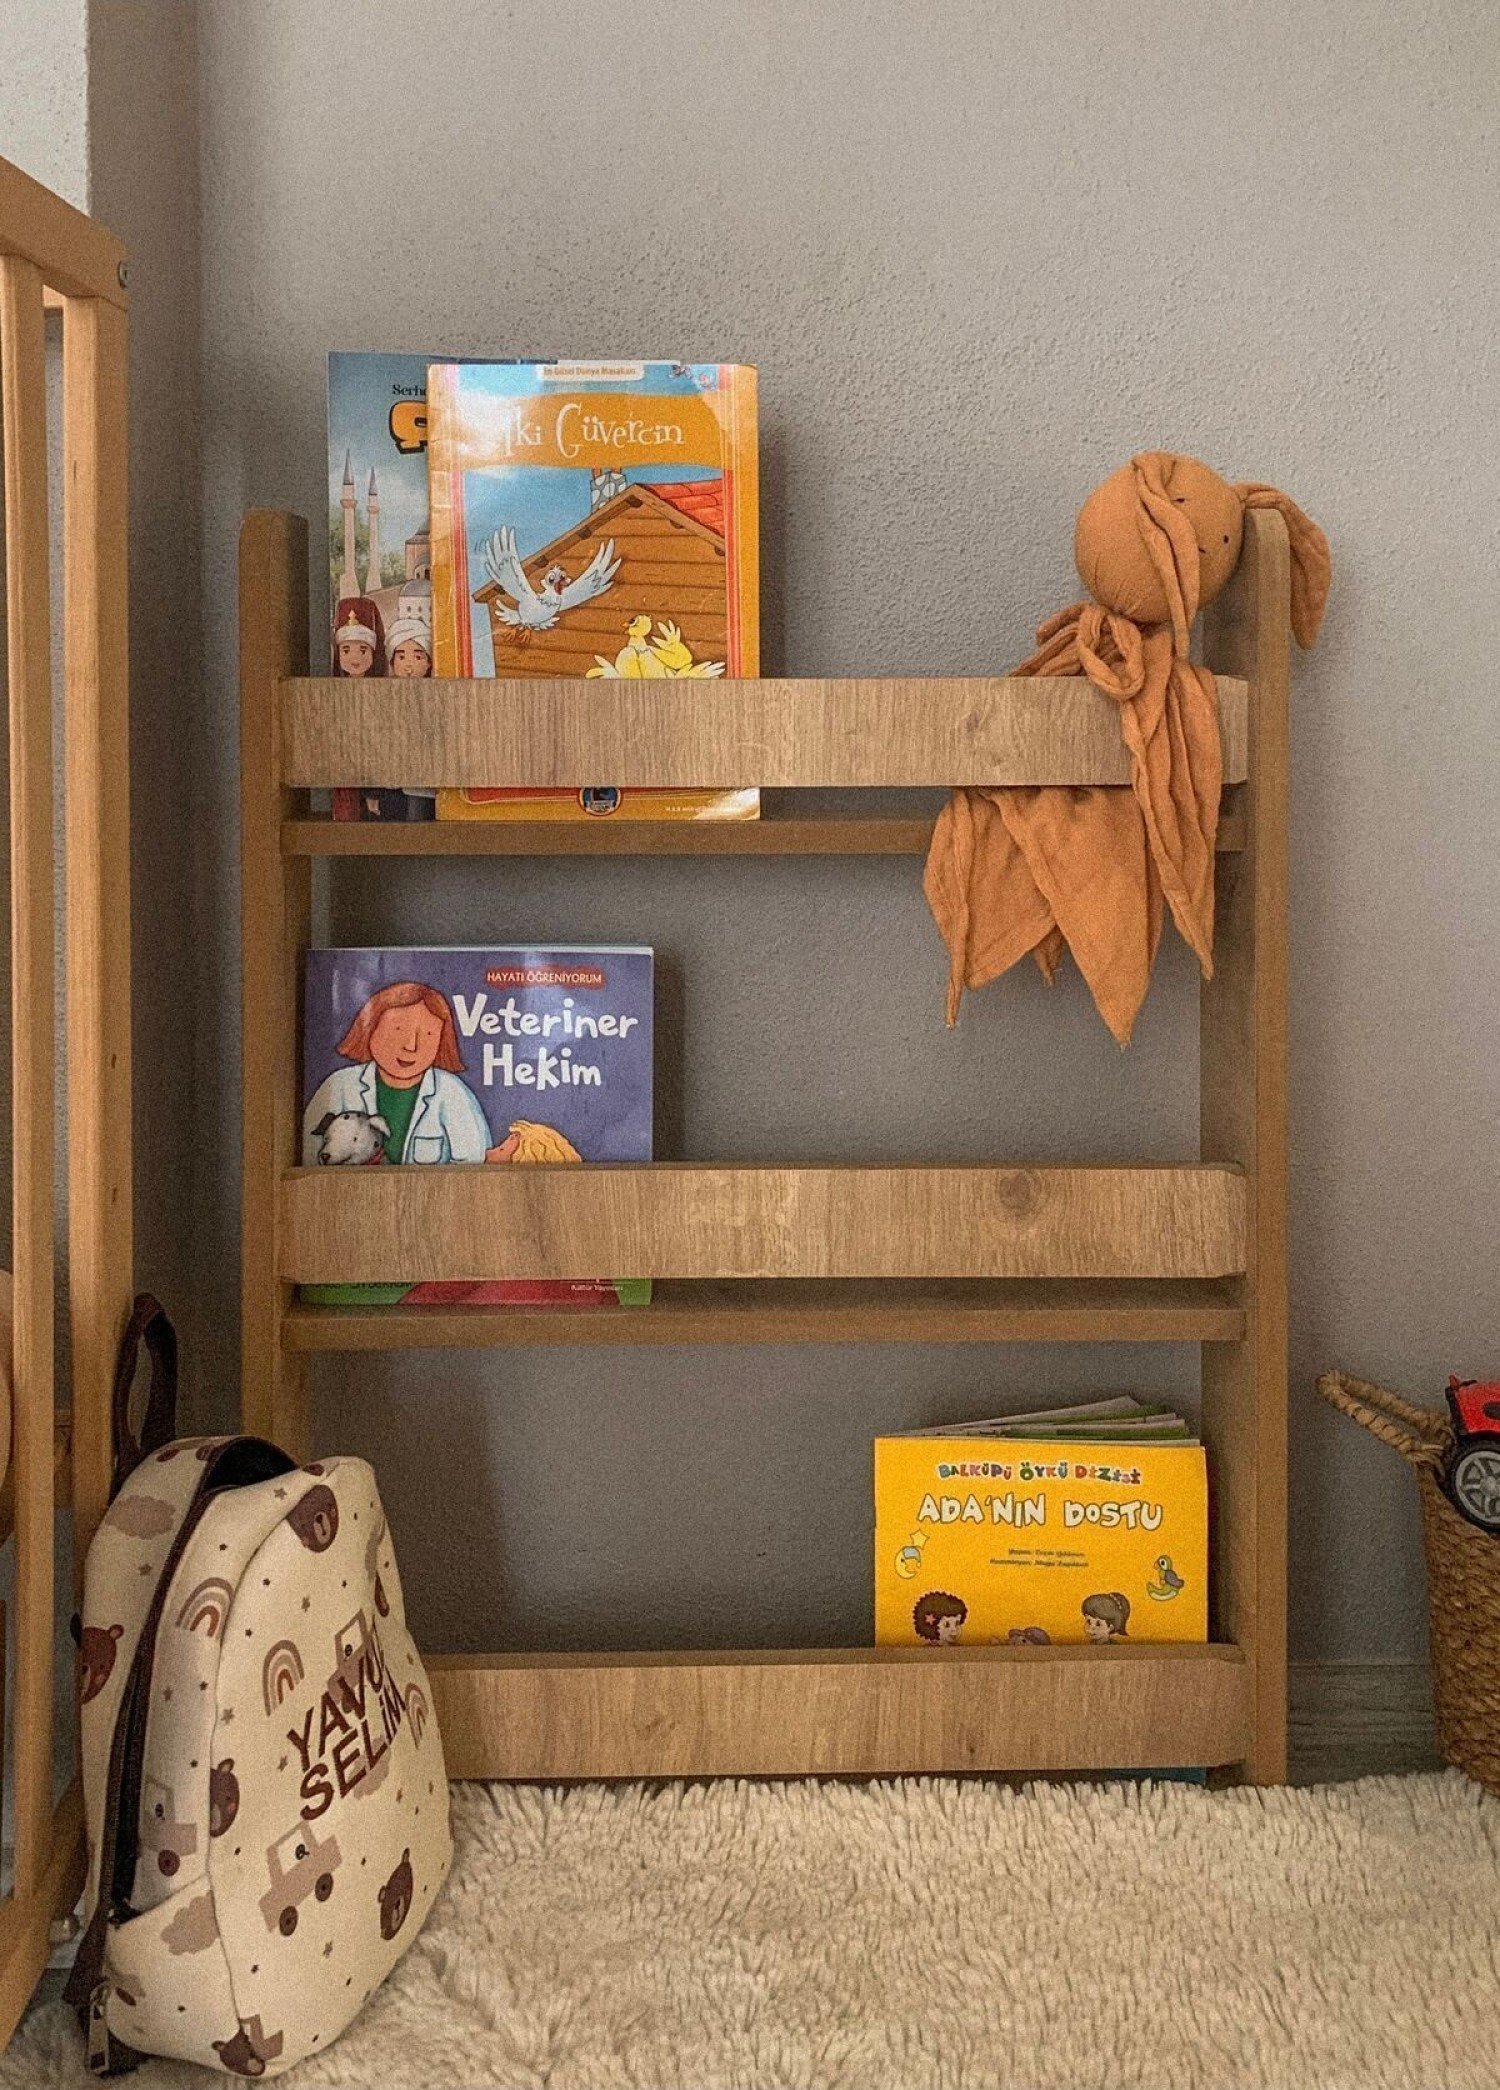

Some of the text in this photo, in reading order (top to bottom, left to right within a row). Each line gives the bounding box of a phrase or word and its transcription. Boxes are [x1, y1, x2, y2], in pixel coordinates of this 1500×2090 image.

[391, 384, 427, 396] Serh
[555, 402, 685, 459] Güvercin
[486, 971, 602, 984] HAYATI ÖĞRENİYORUM
[452, 992, 639, 1039] Veteriner
[483, 1043, 602, 1091] Hekim
[1019, 1461, 1069, 1481] ÖYKÜ
[917, 1491, 1163, 1531] ADA'NIN DOSTU
[286, 1614, 385, 1773] YAVU
